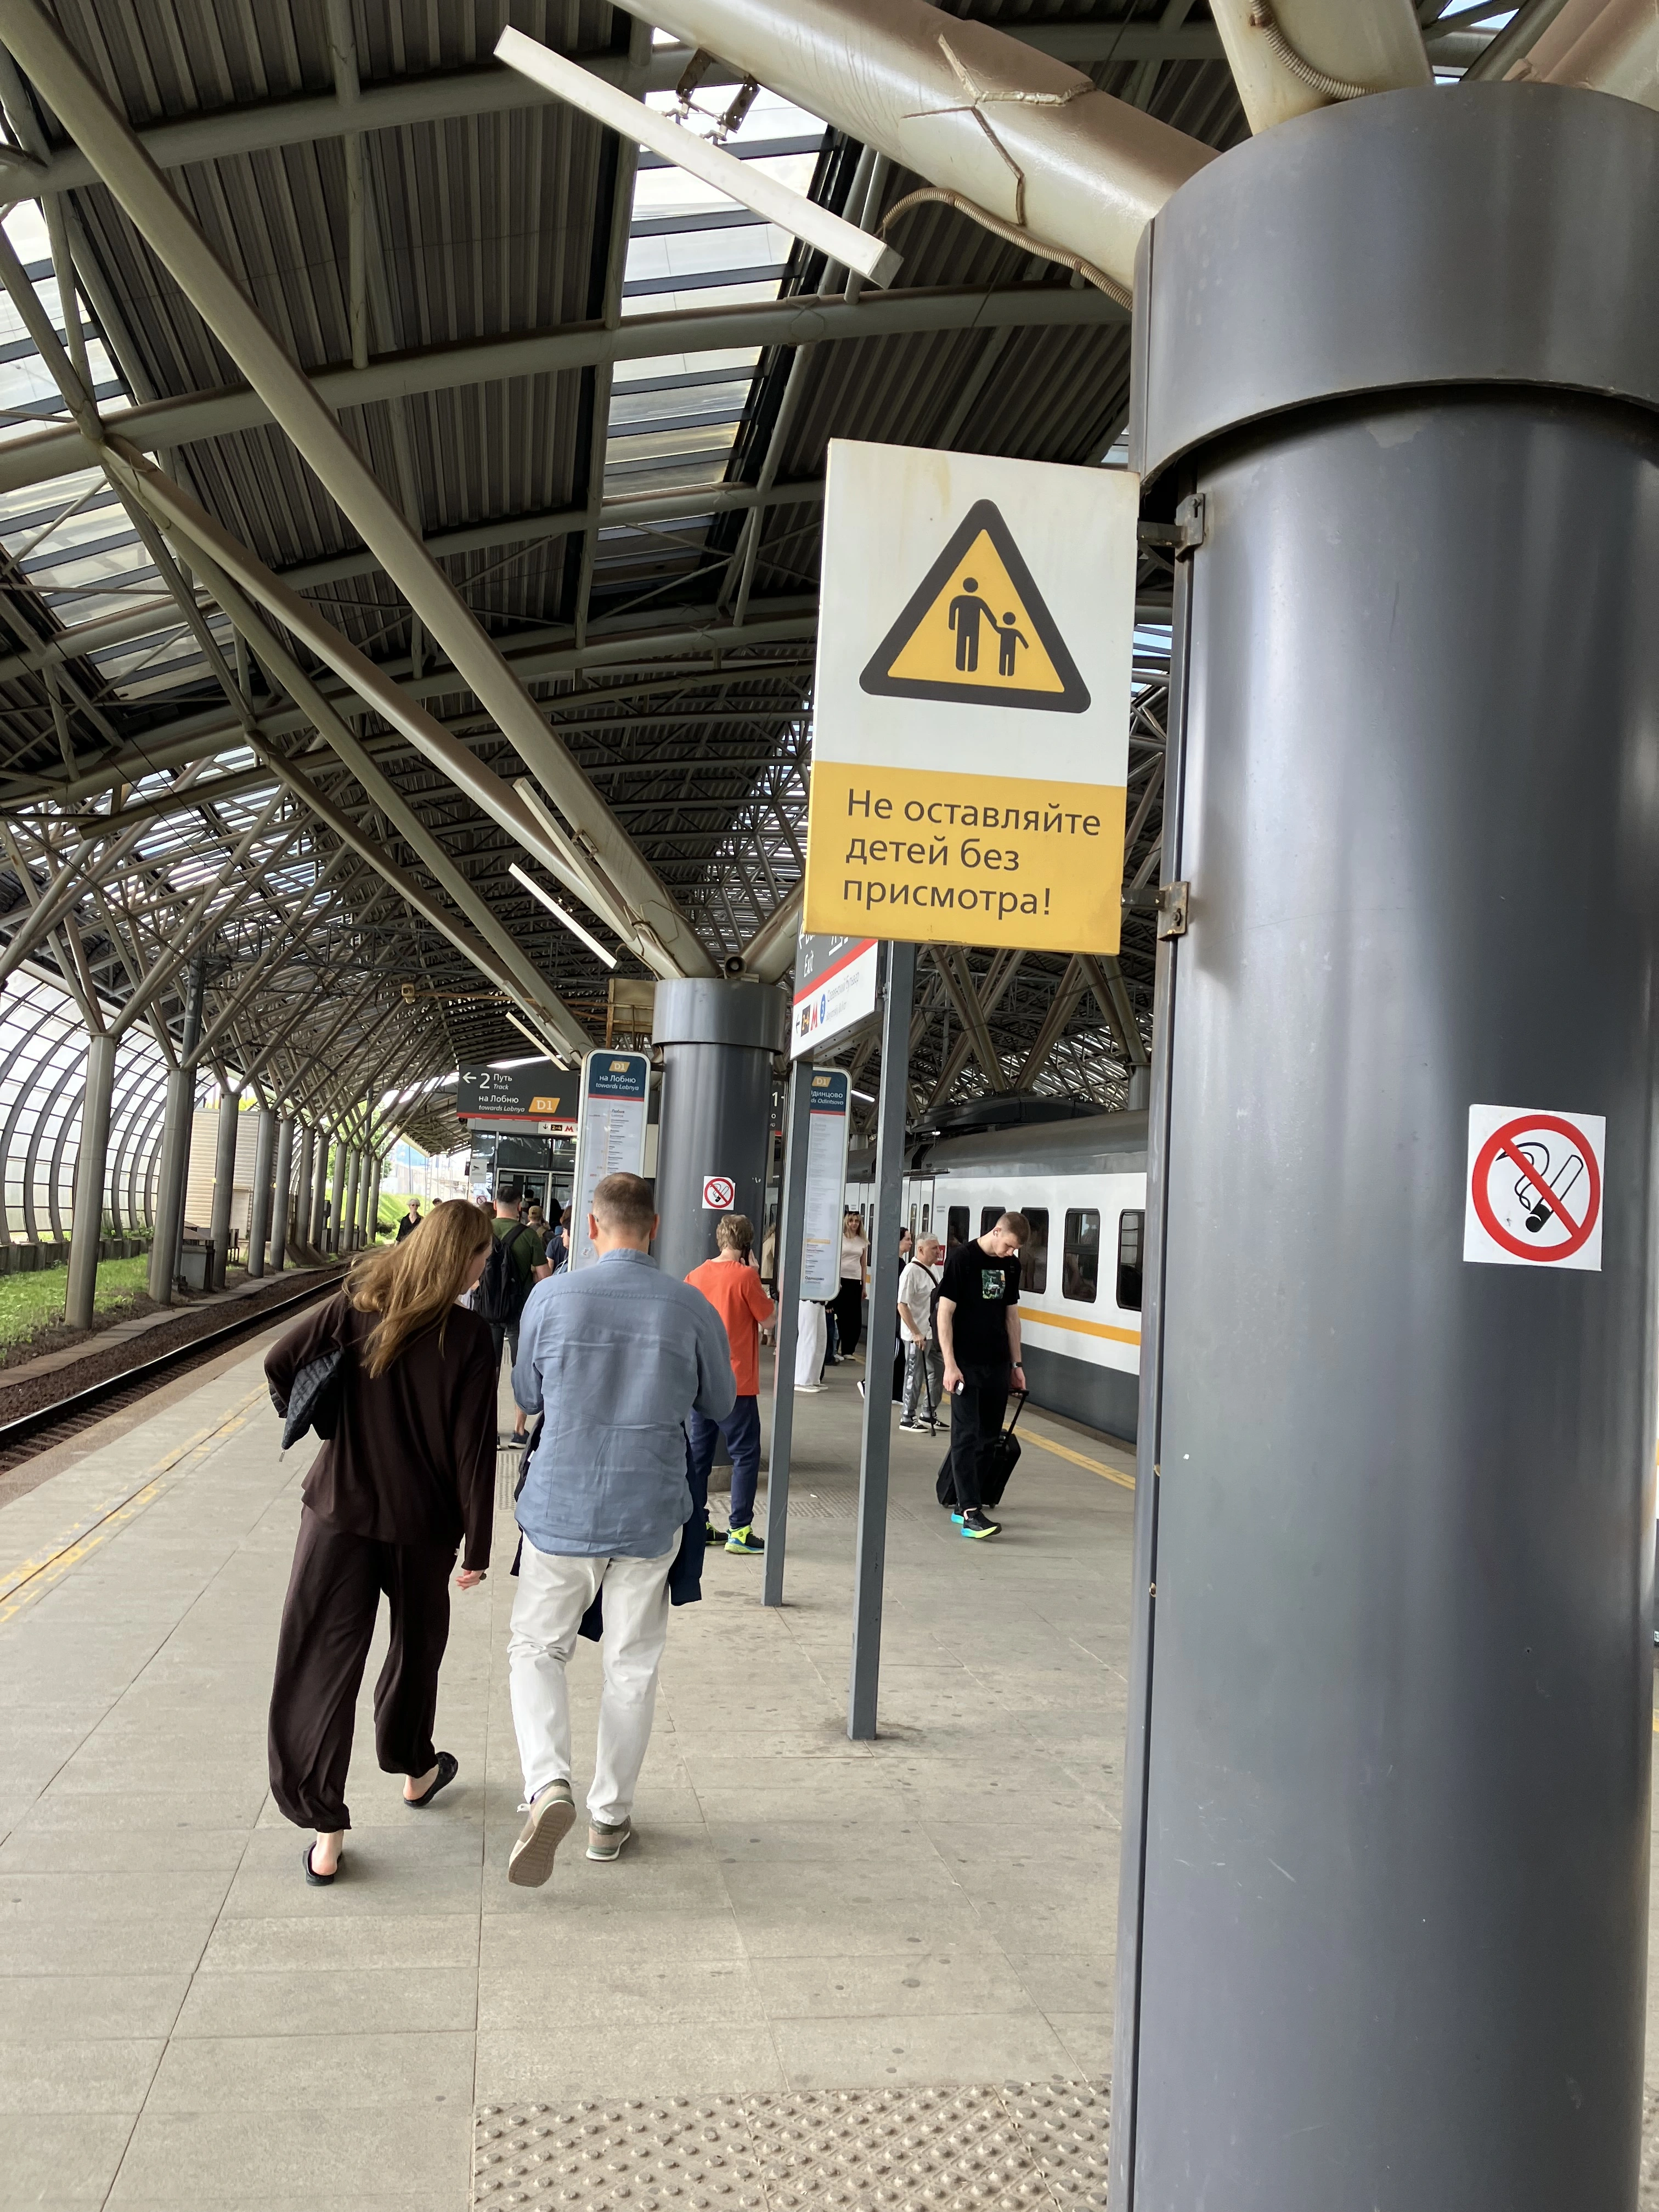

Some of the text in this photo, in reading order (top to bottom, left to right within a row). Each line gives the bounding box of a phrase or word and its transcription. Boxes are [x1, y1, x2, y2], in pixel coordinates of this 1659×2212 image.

[848, 788, 1101, 836] Не оставляйте
[845, 835, 1019, 871] детей без
[843, 879, 1051, 920] присмотра!
[804, 950, 814, 978] Exit
[479, 1073, 490, 1089] 2
[494, 1074, 512, 1083] Путь
[490, 1094, 519, 1103] Лобню
[537, 1100, 553, 1110] D1
